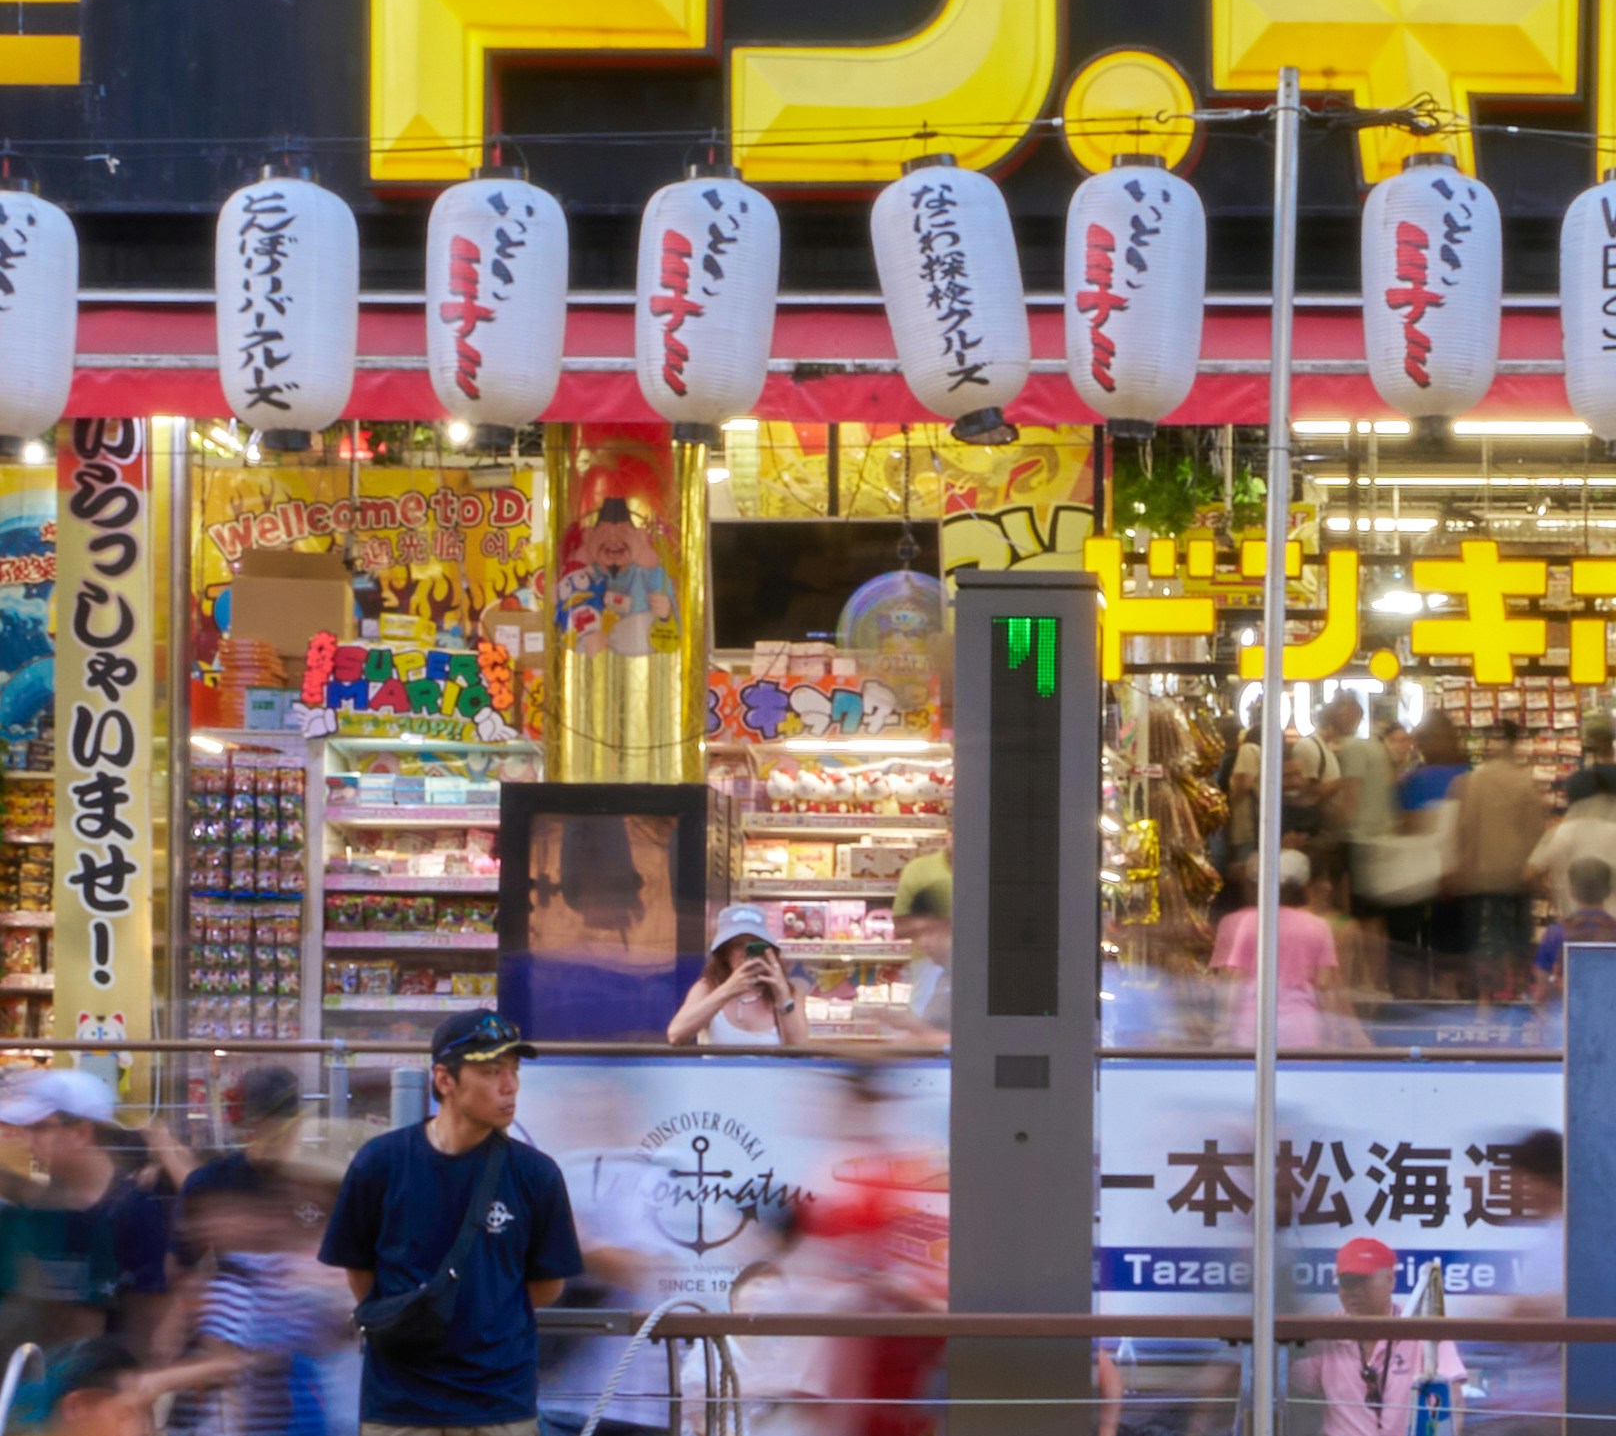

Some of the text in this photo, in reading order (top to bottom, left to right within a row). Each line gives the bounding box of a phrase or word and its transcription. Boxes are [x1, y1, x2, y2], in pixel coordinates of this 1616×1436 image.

[441, 234, 496, 401] ミナミ
[650, 228, 705, 396] ミナミ
[911, 184, 992, 394] なにわ探検クルーズ
[1076, 221, 1129, 393] ミナミ
[1384, 220, 1444, 389] ミナミ
[207, 491, 428, 561] Wellcome
[431, 489, 483, 527] to
[327, 678, 491, 718] MARIO
[333, 646, 479, 688] SUPER
[724, 1118, 766, 1162] OSAKA
[658, 1279, 706, 1293] SINCE
[1124, 1254, 1339, 1286] Tazaeon
